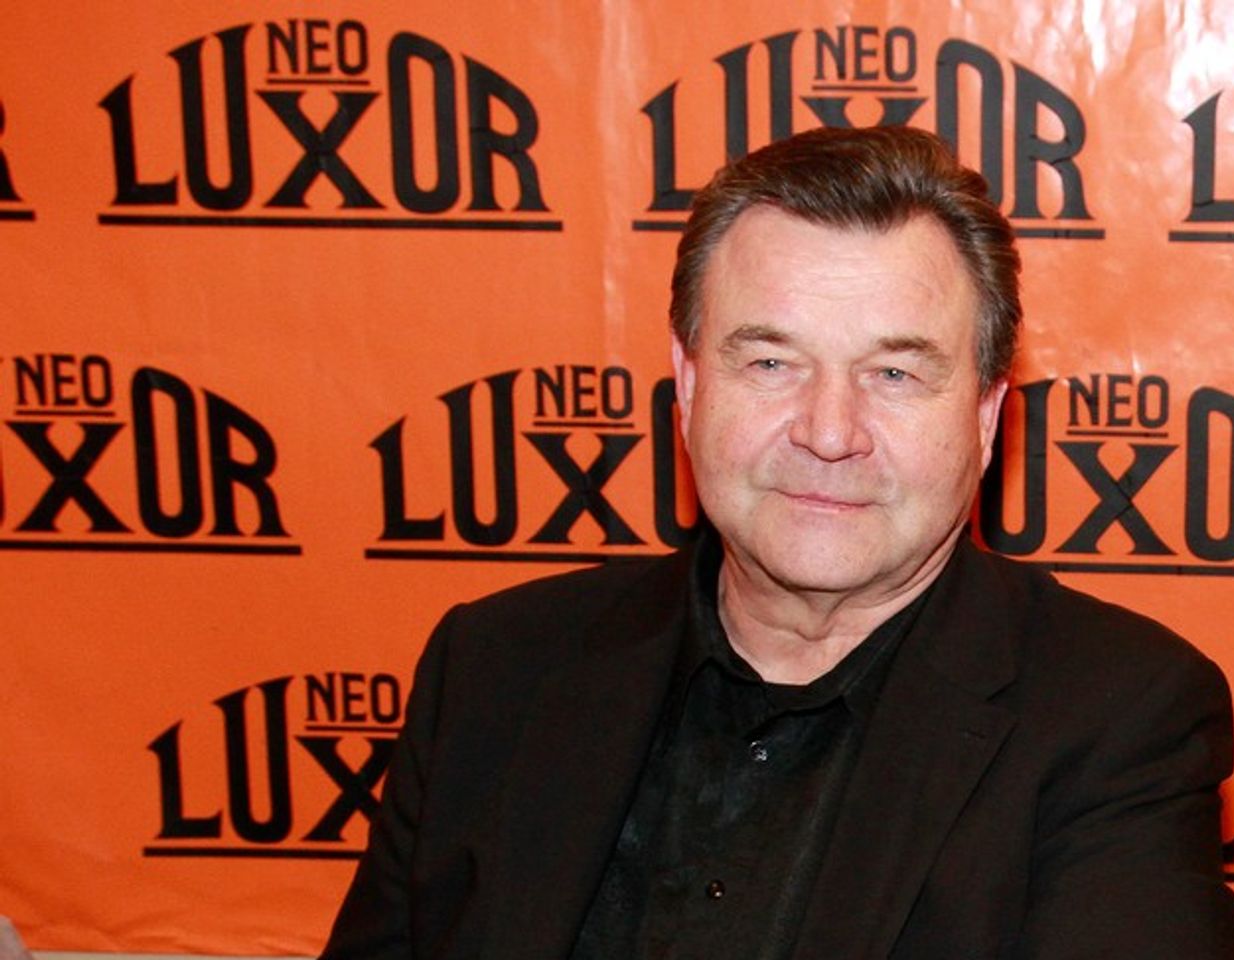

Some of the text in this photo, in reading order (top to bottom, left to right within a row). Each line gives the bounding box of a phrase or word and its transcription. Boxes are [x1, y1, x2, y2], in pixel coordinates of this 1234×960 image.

[266, 18, 370, 75] NEO
[813, 25, 918, 83] NEO
[98, 23, 552, 214] LUXOR
[641, 29, 1096, 221] LUOR
[13, 354, 115, 408] NEO
[533, 365, 635, 419] NEO
[1067, 373, 1170, 429] NEO
[0, 360, 293, 539] XOR
[368, 368, 699, 547] LUXO
[304, 671, 400, 724] NEO
[146, 675, 402, 844] LUX
